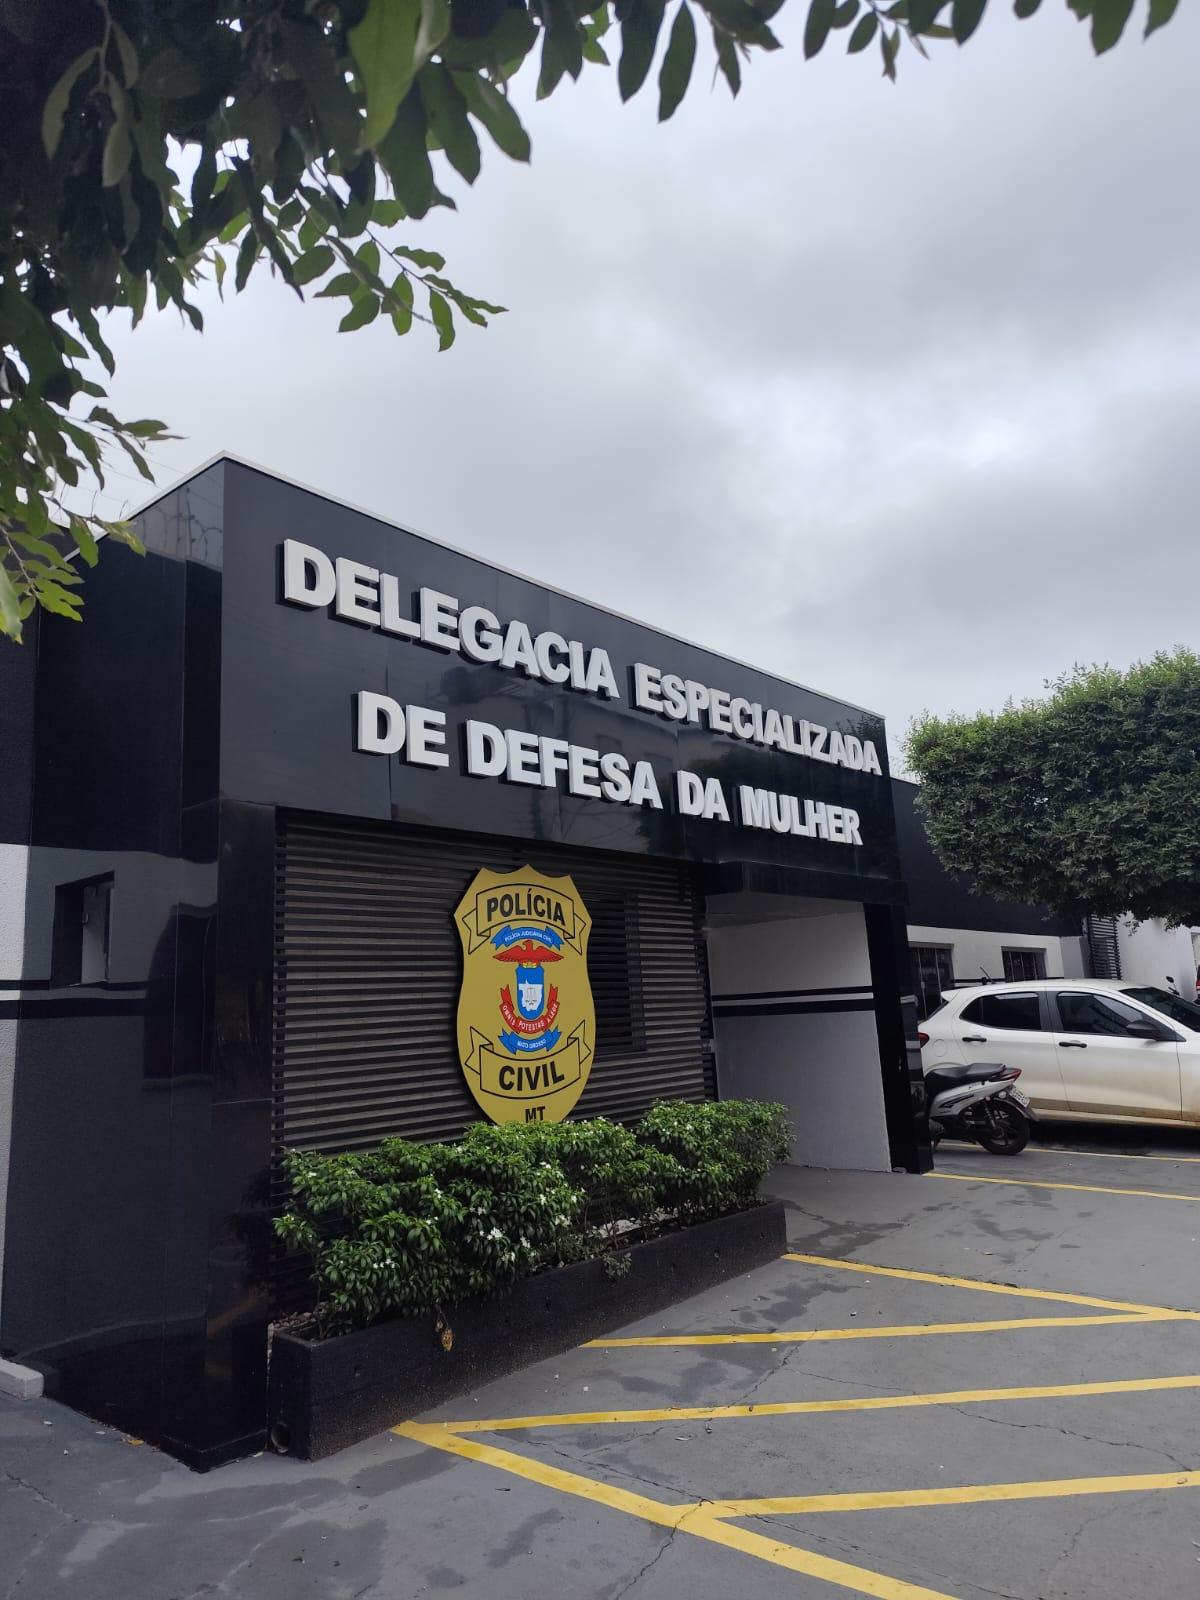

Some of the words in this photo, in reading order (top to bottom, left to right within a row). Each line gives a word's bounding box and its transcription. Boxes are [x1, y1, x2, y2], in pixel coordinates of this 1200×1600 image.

[283, 538, 620, 698] DELEGACIA
[634, 662, 882, 776] ESPECIALIZADA
[357, 690, 449, 768] DE
[466, 719, 663, 809] DEFESA
[677, 770, 730, 822] DA
[739, 785, 863, 846] MULHER
[487, 888, 566, 926] POLÍCIA
[499, 1061, 565, 1091] CIVIL
[525, 1105, 546, 1124] MT
